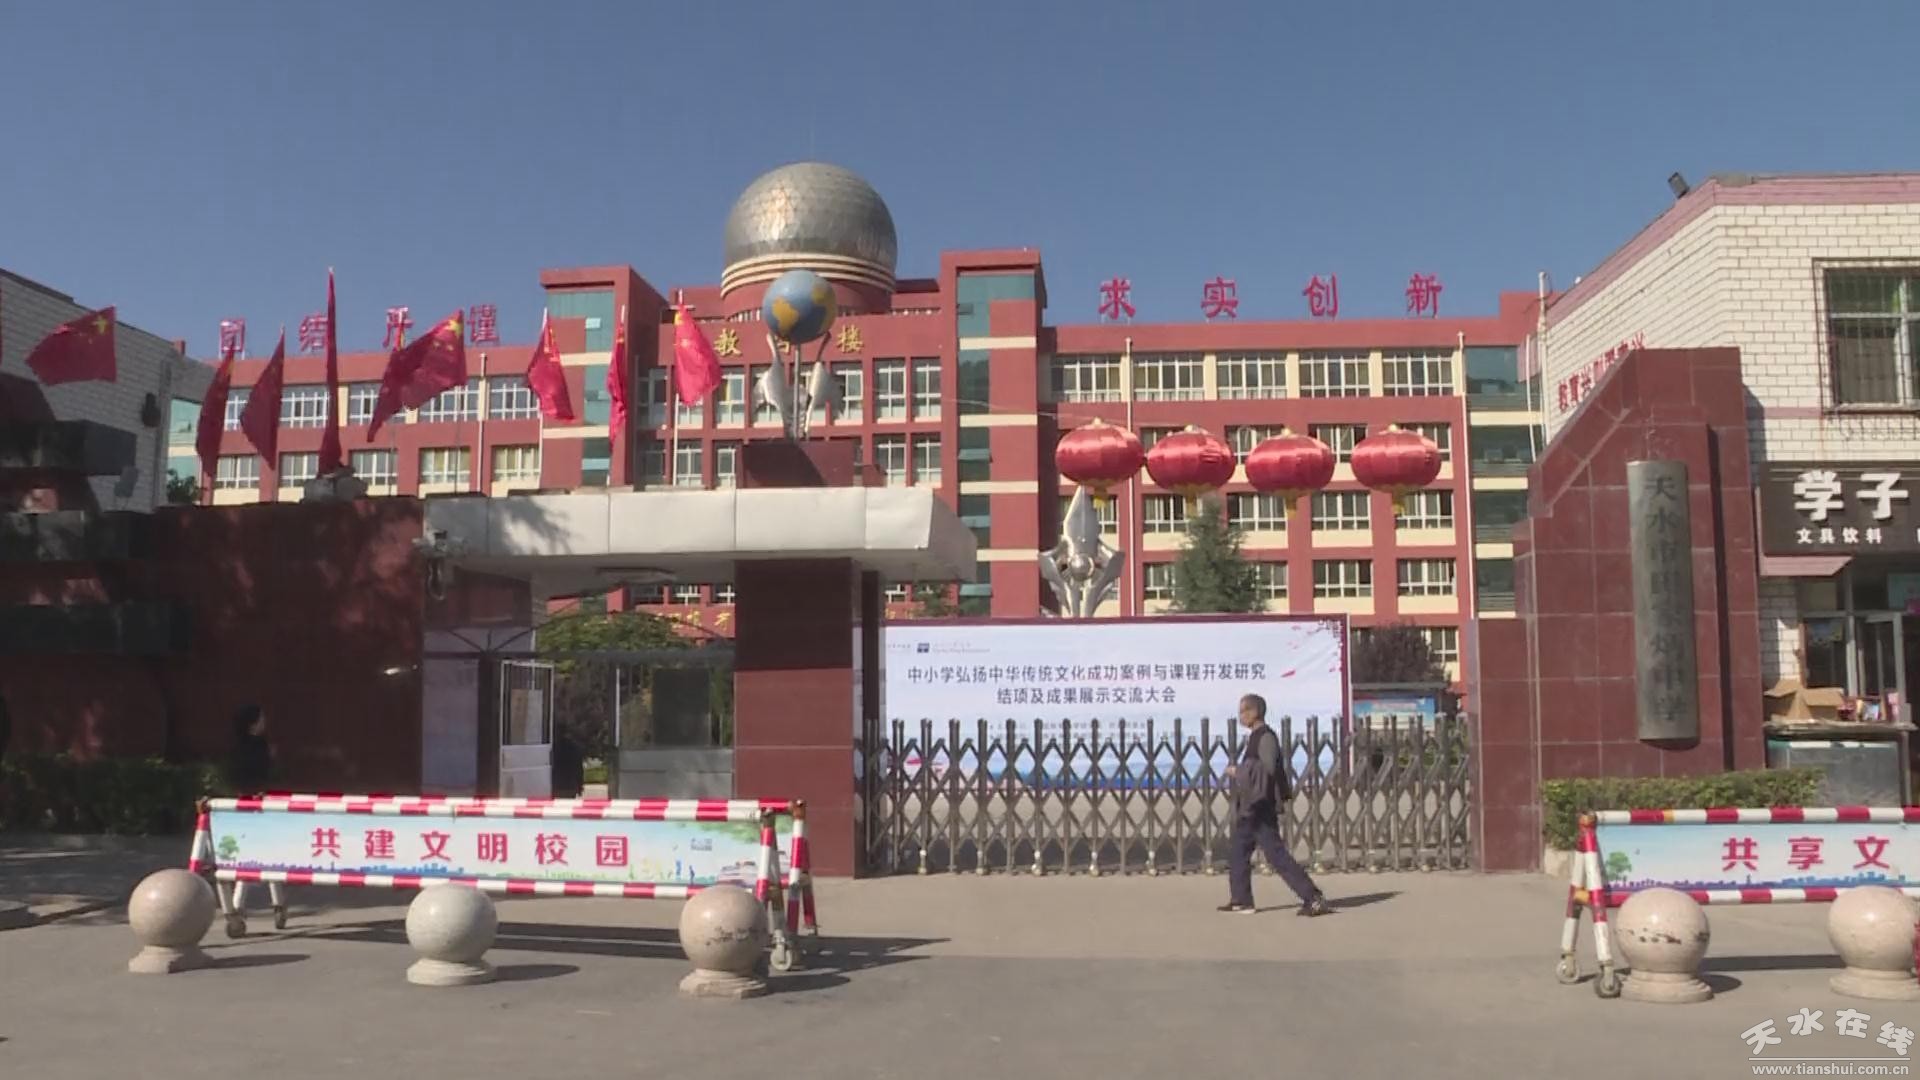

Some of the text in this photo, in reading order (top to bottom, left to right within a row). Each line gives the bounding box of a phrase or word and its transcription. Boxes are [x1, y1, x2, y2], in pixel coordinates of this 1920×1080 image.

[1098, 273, 1442, 320] 求实创新
[1793, 469, 1909, 521] 学子
[1796, 527, 1882, 544] 文具饮料
[907, 662, 1266, 684] 中小学弘扬中华传统文化成功案例与课程开发研究
[996, 686, 1176, 705] 结项及成果展示交流大会
[310, 828, 629, 867] 共建文明校园
[1722, 836, 1891, 872] 共享文
